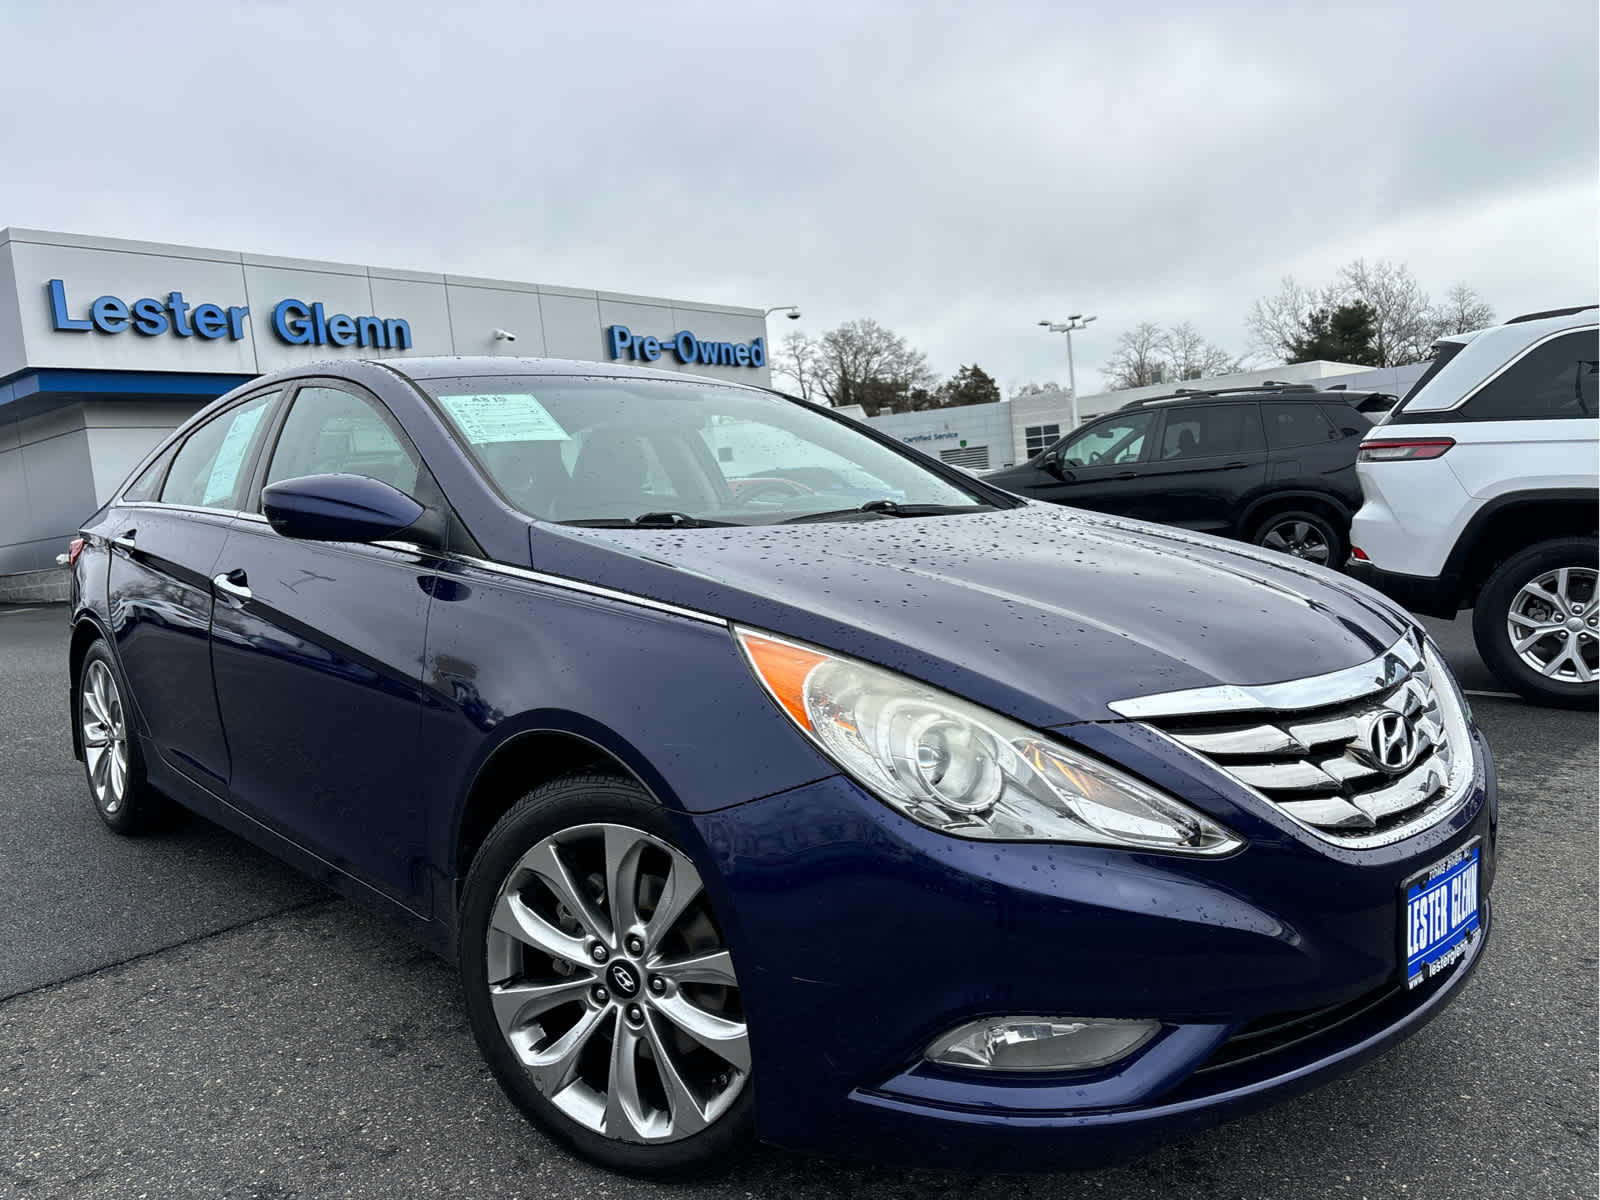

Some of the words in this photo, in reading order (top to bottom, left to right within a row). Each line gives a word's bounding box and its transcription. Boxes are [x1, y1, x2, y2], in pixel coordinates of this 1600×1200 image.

[47, 279, 249, 341] Lester
[271, 298, 412, 349] Glenn
[608, 324, 766, 367] Pre-Owned
[934, 432, 958, 440] Service
[1408, 885, 1448, 957] LESTER
[1451, 862, 1478, 929] GLENN
